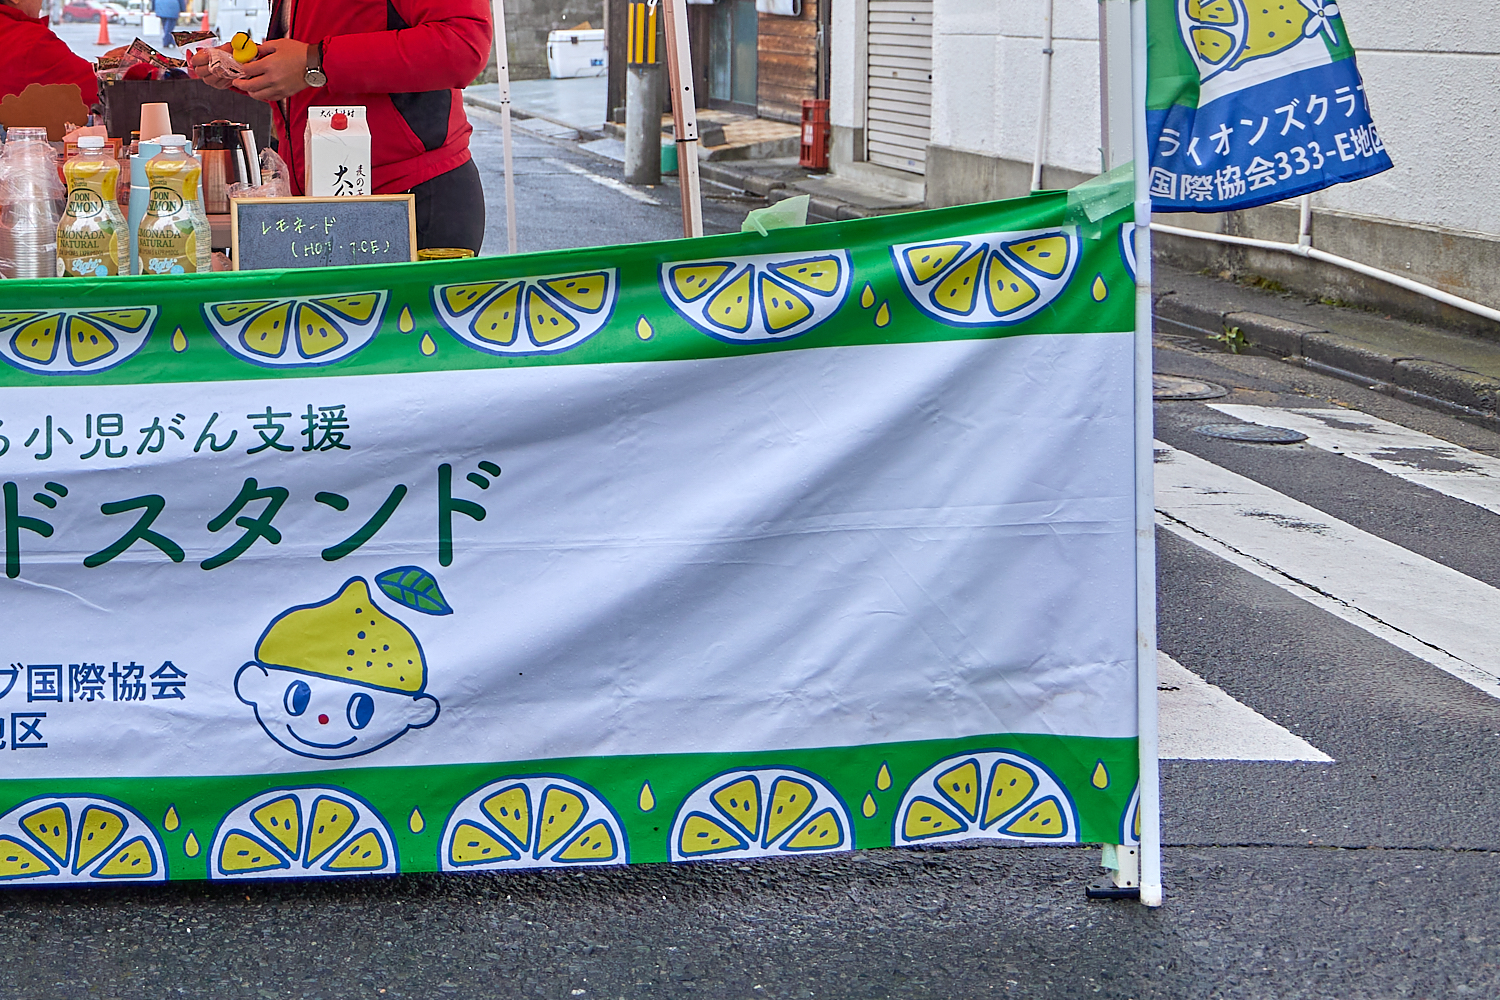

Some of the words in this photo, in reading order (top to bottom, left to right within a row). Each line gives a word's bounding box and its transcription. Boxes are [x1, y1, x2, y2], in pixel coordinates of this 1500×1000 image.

[75, 192, 90, 201] DON
[154, 191, 169, 200] DON
[261, 216, 338, 236] レモネード
[138, 229, 182, 239] MONADA
[59, 240, 100, 249] NATURAL
